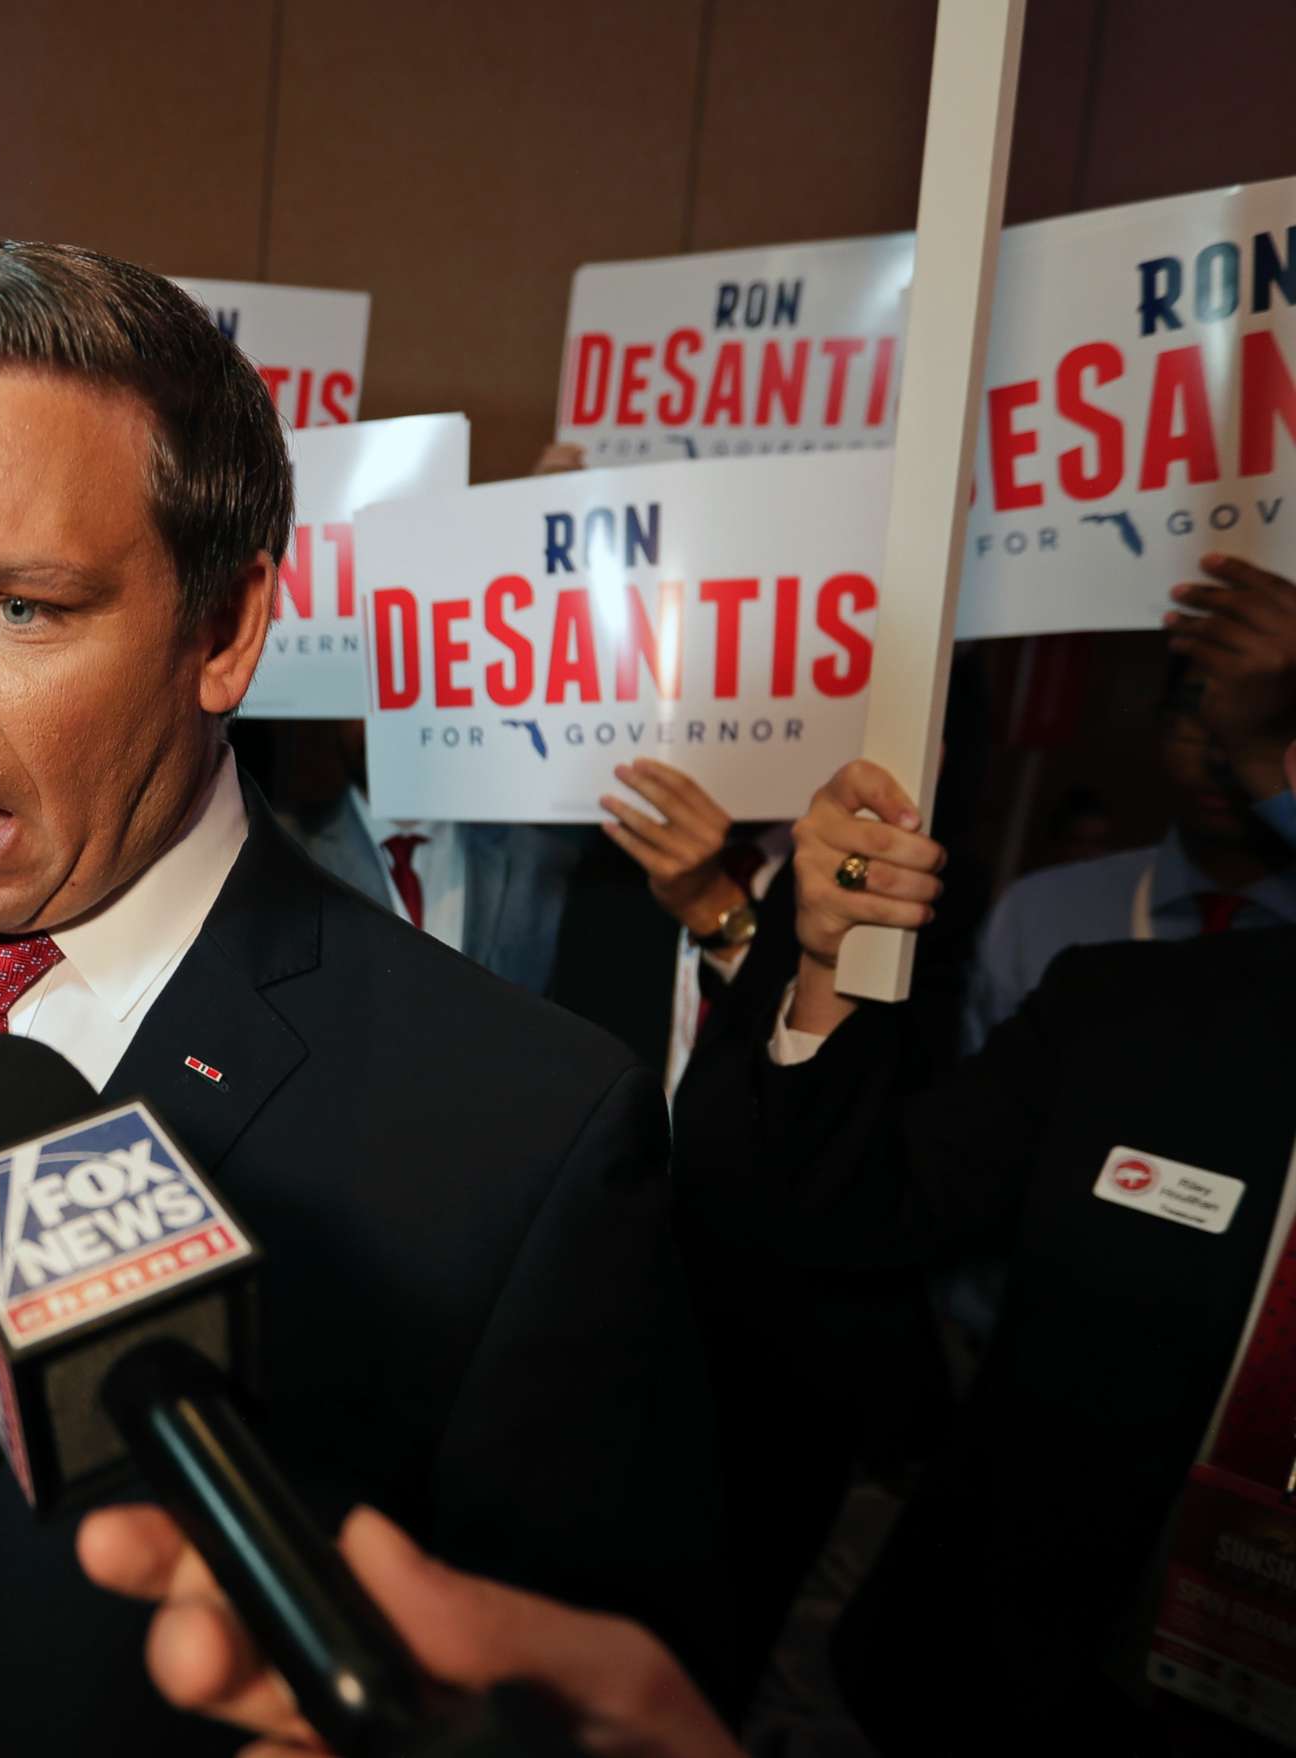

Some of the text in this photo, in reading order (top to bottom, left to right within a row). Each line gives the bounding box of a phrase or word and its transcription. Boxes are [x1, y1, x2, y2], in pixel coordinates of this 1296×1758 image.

[715, 278, 803, 331] RON
[1136, 226, 1296, 338] RON
[544, 503, 660, 574] RON
[976, 528, 1058, 557] FOR
[421, 718, 804, 747] FOR GOVERNOR
[27, 1138, 176, 1226] FOX
[11, 1182, 205, 1286] NEWS
[17, 1229, 227, 1327] channel
